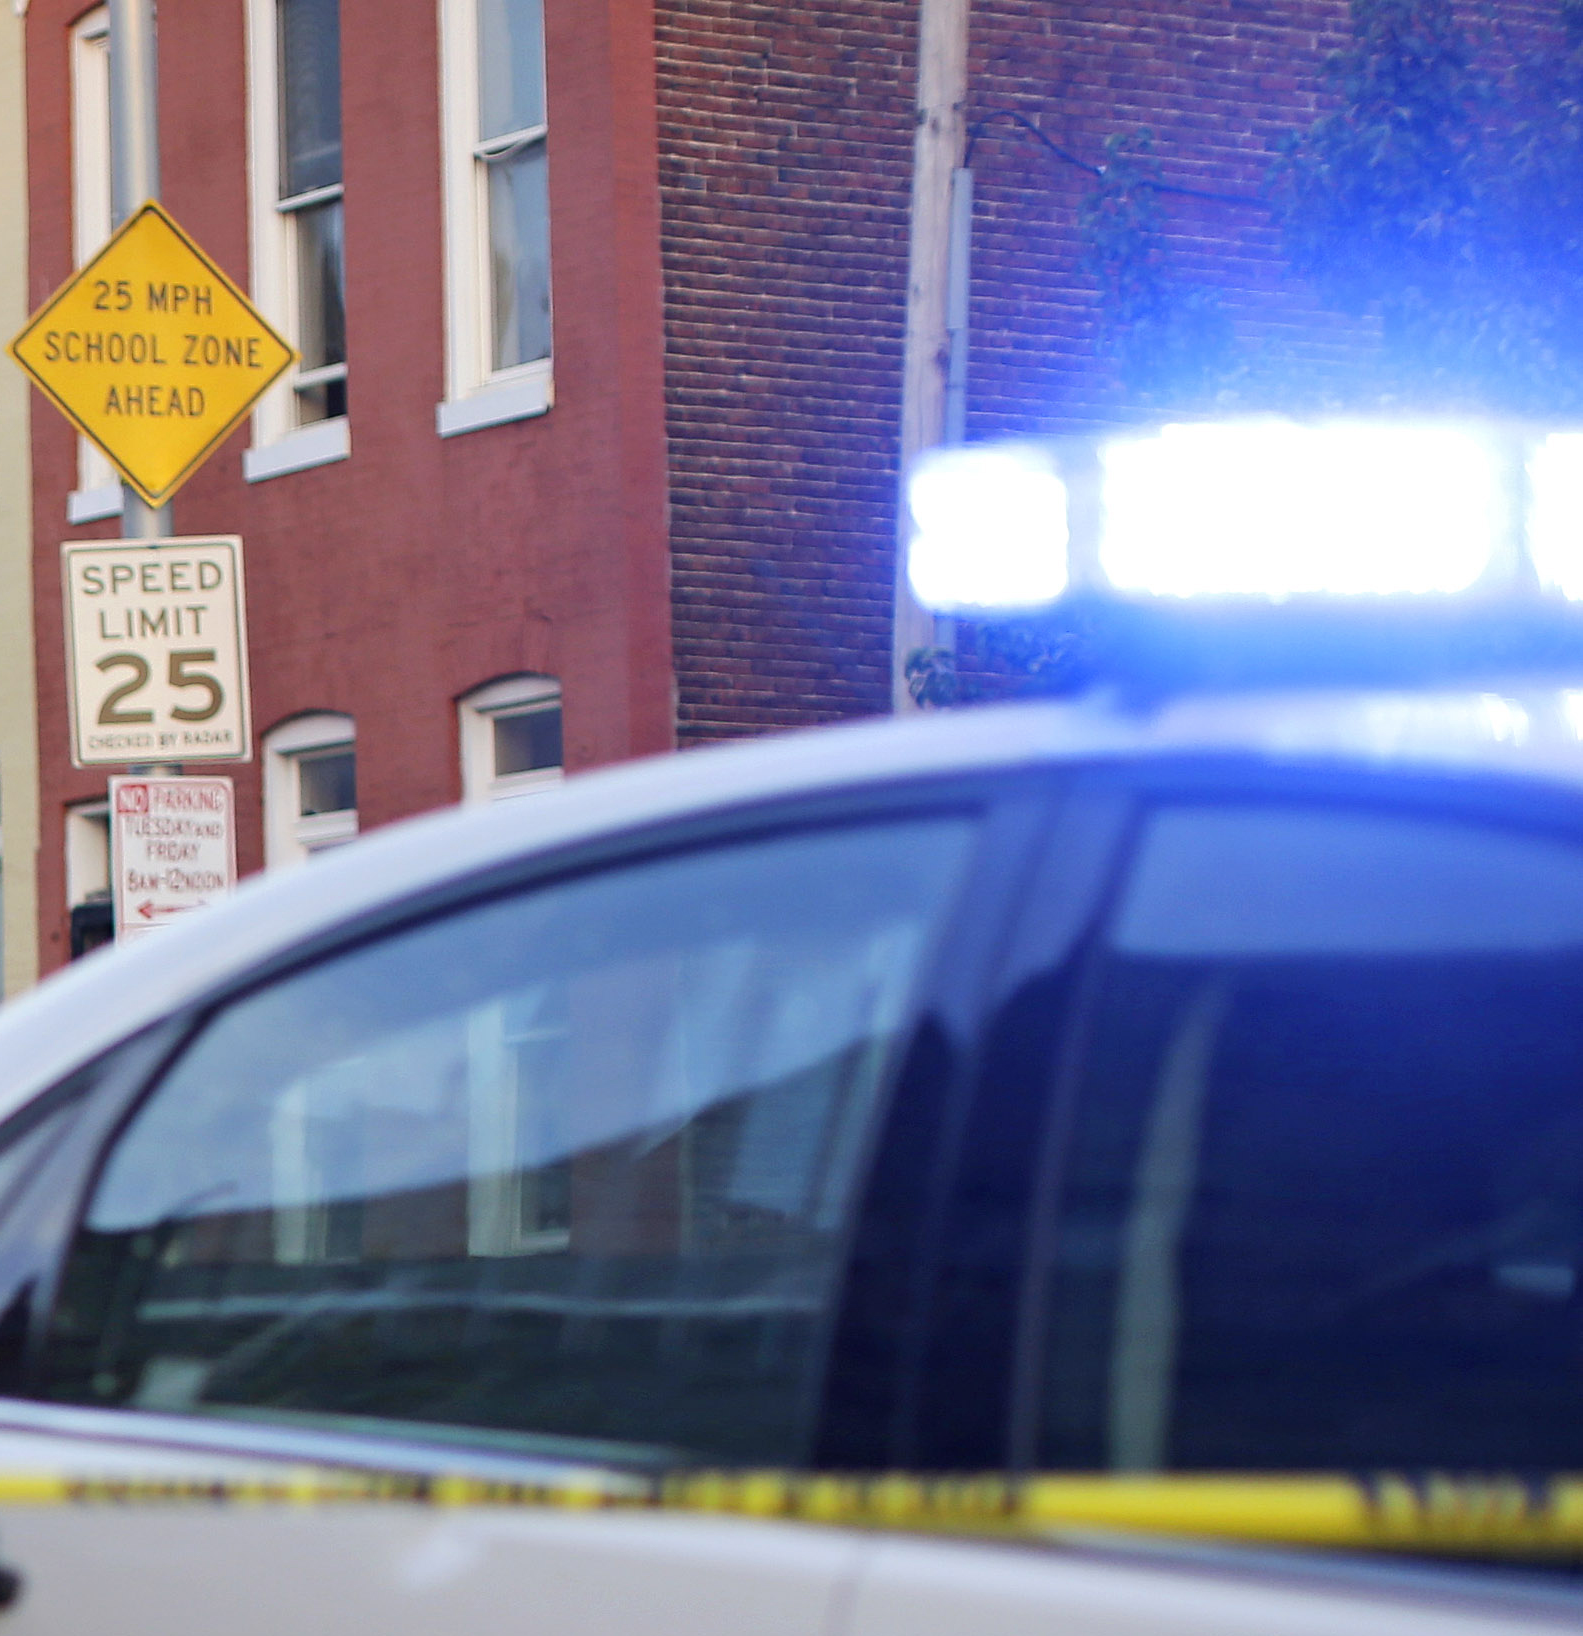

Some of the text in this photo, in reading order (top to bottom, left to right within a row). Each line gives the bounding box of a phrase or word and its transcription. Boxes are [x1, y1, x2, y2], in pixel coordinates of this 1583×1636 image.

[94, 280, 212, 315] 25 MPH
[44, 331, 263, 368] SCHOOL ZONE
[105, 385, 206, 417] AHEAD
[82, 561, 223, 596] SPEED
[99, 605, 208, 639] LIMIT
[95, 649, 225, 724] 25
[118, 787, 146, 812] NO
[146, 840, 200, 861] FRIDAY
